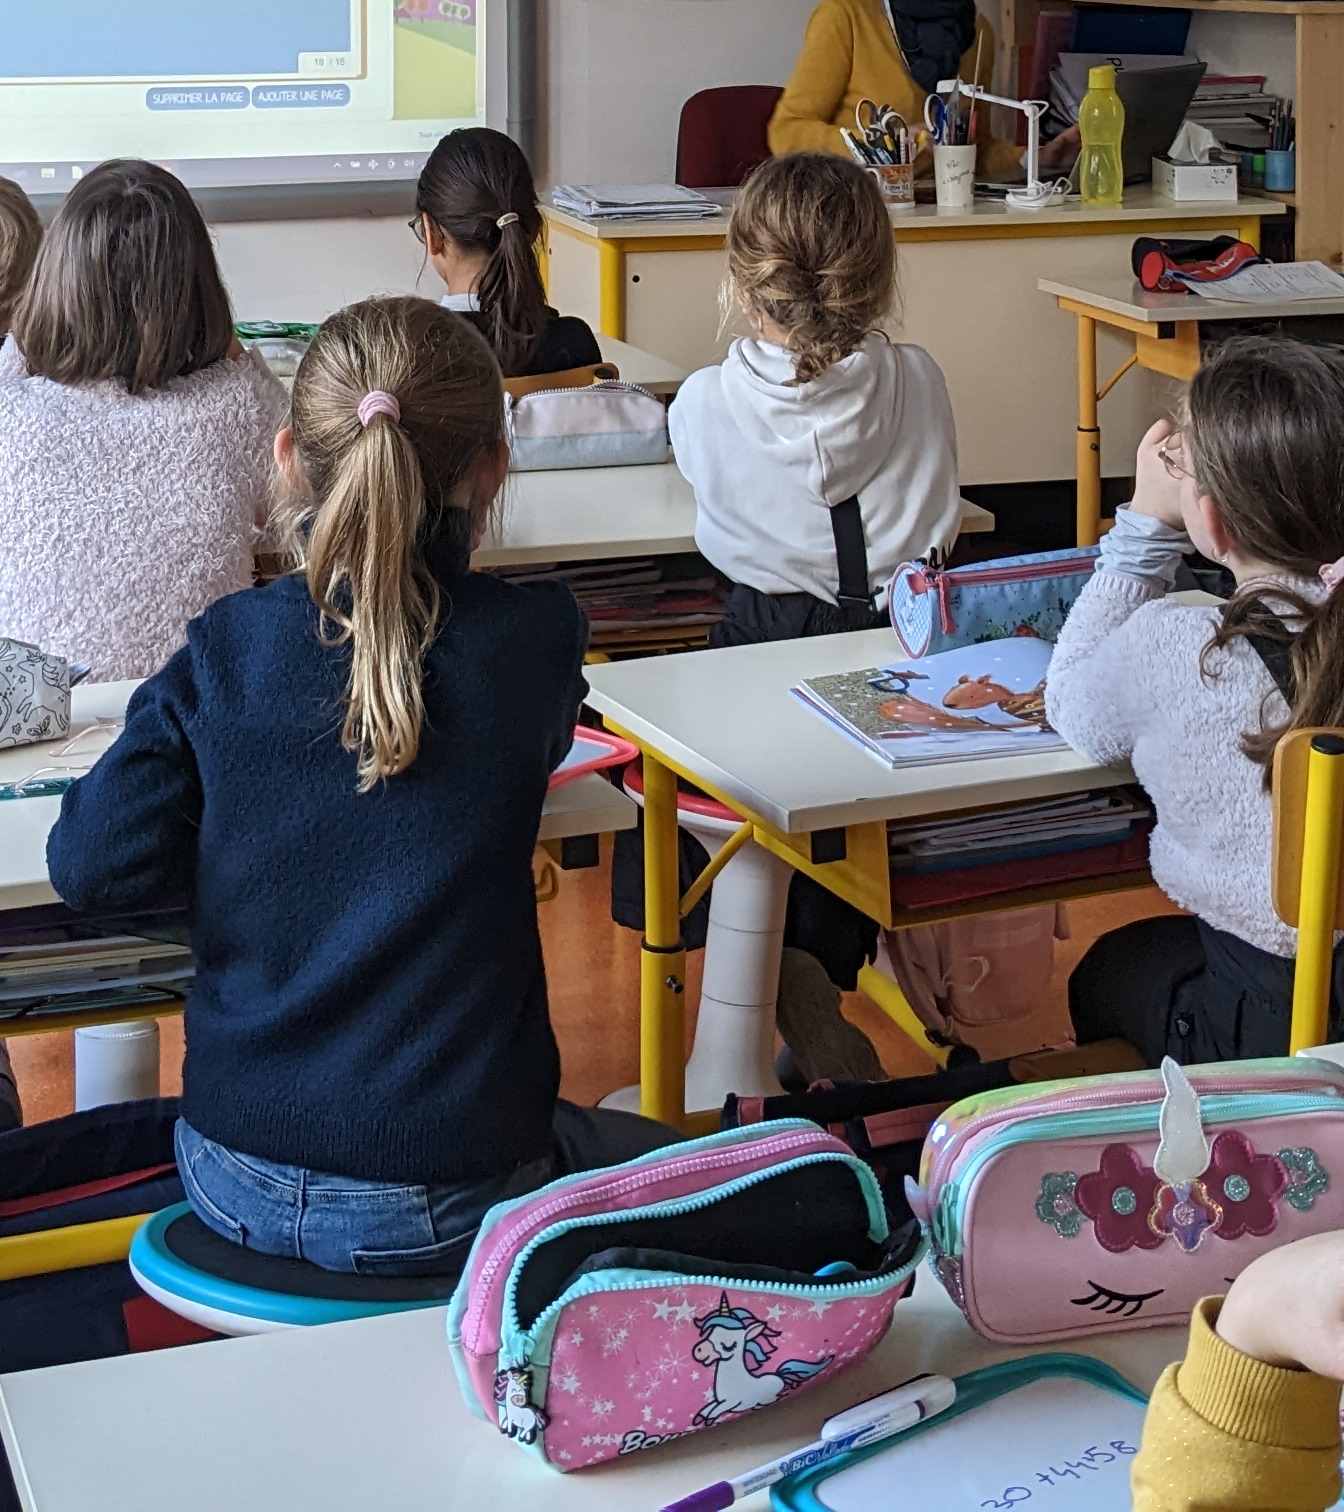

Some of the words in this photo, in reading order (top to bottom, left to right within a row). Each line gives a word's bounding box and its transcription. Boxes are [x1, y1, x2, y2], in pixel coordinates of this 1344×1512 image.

[152, 93, 203, 104] SUPPRIMER
[206, 93, 218, 104] LA
[220, 93, 244, 103] PAGE
[258, 91, 297, 102] AJOUTER
[299, 90, 318, 101] UNE
[321, 89, 344, 100] PAGE
